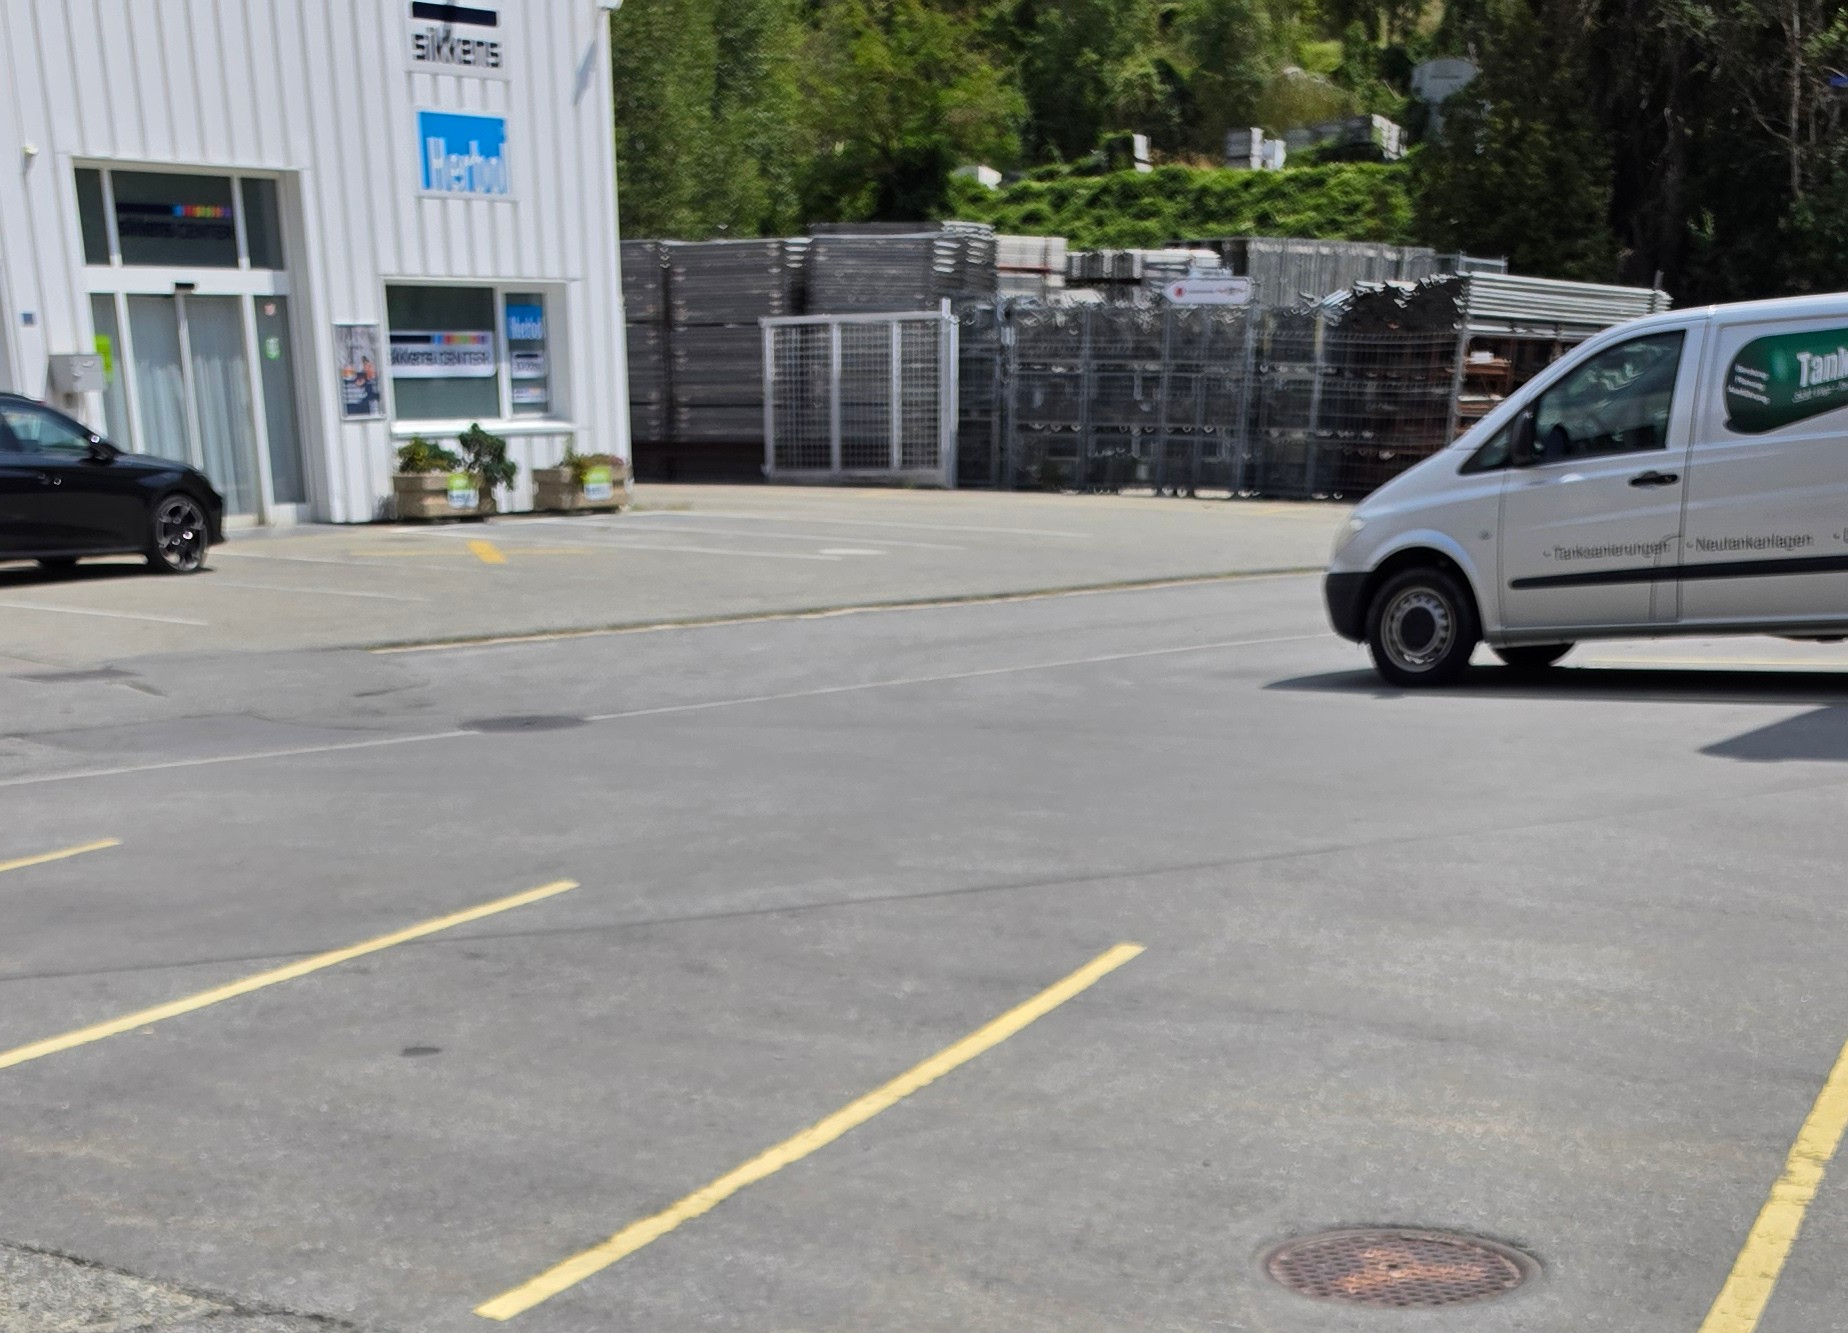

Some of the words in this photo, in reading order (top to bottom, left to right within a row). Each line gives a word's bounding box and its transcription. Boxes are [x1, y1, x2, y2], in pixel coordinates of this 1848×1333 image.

[412, 26, 501, 67] sikkens
[425, 137, 507, 193] Herbol
[1695, 533, 1813, 551] Neutankanlagen
